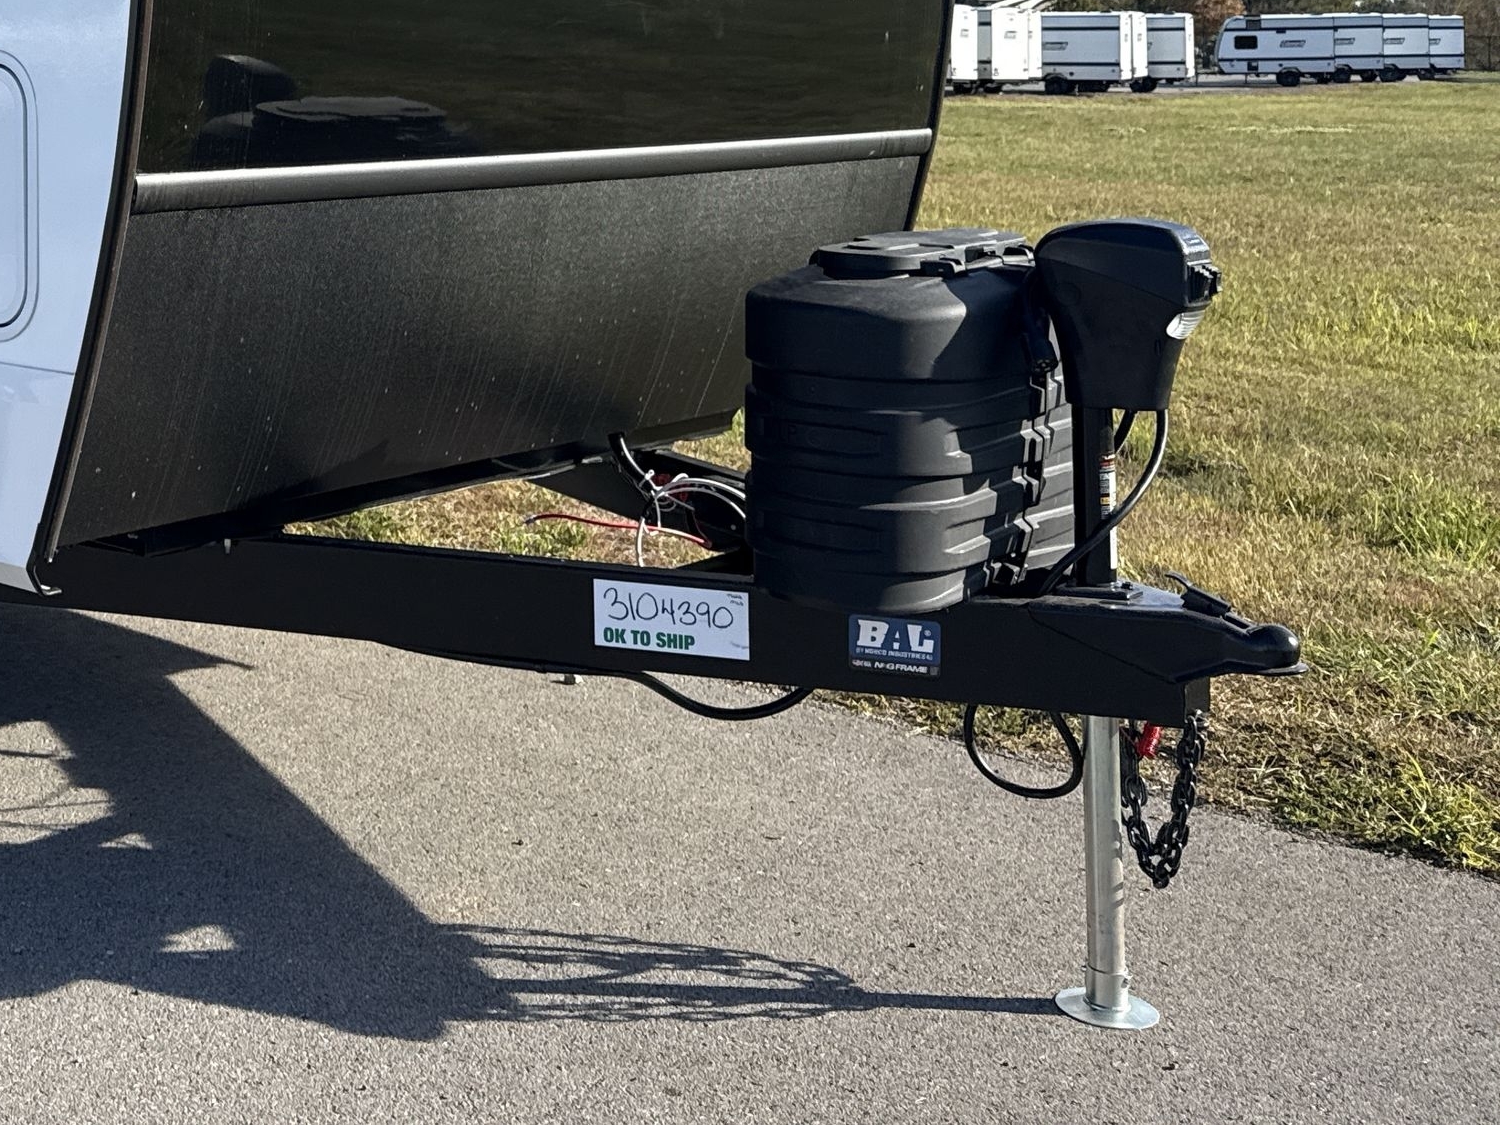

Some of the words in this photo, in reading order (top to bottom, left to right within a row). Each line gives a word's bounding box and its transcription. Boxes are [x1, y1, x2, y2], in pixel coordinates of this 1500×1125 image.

[603, 587, 734, 629] 3104390
[603, 627, 627, 644] OK
[630, 629, 651, 647] TO
[656, 631, 696, 650] SHIP
[856, 619, 935, 653] BAL
